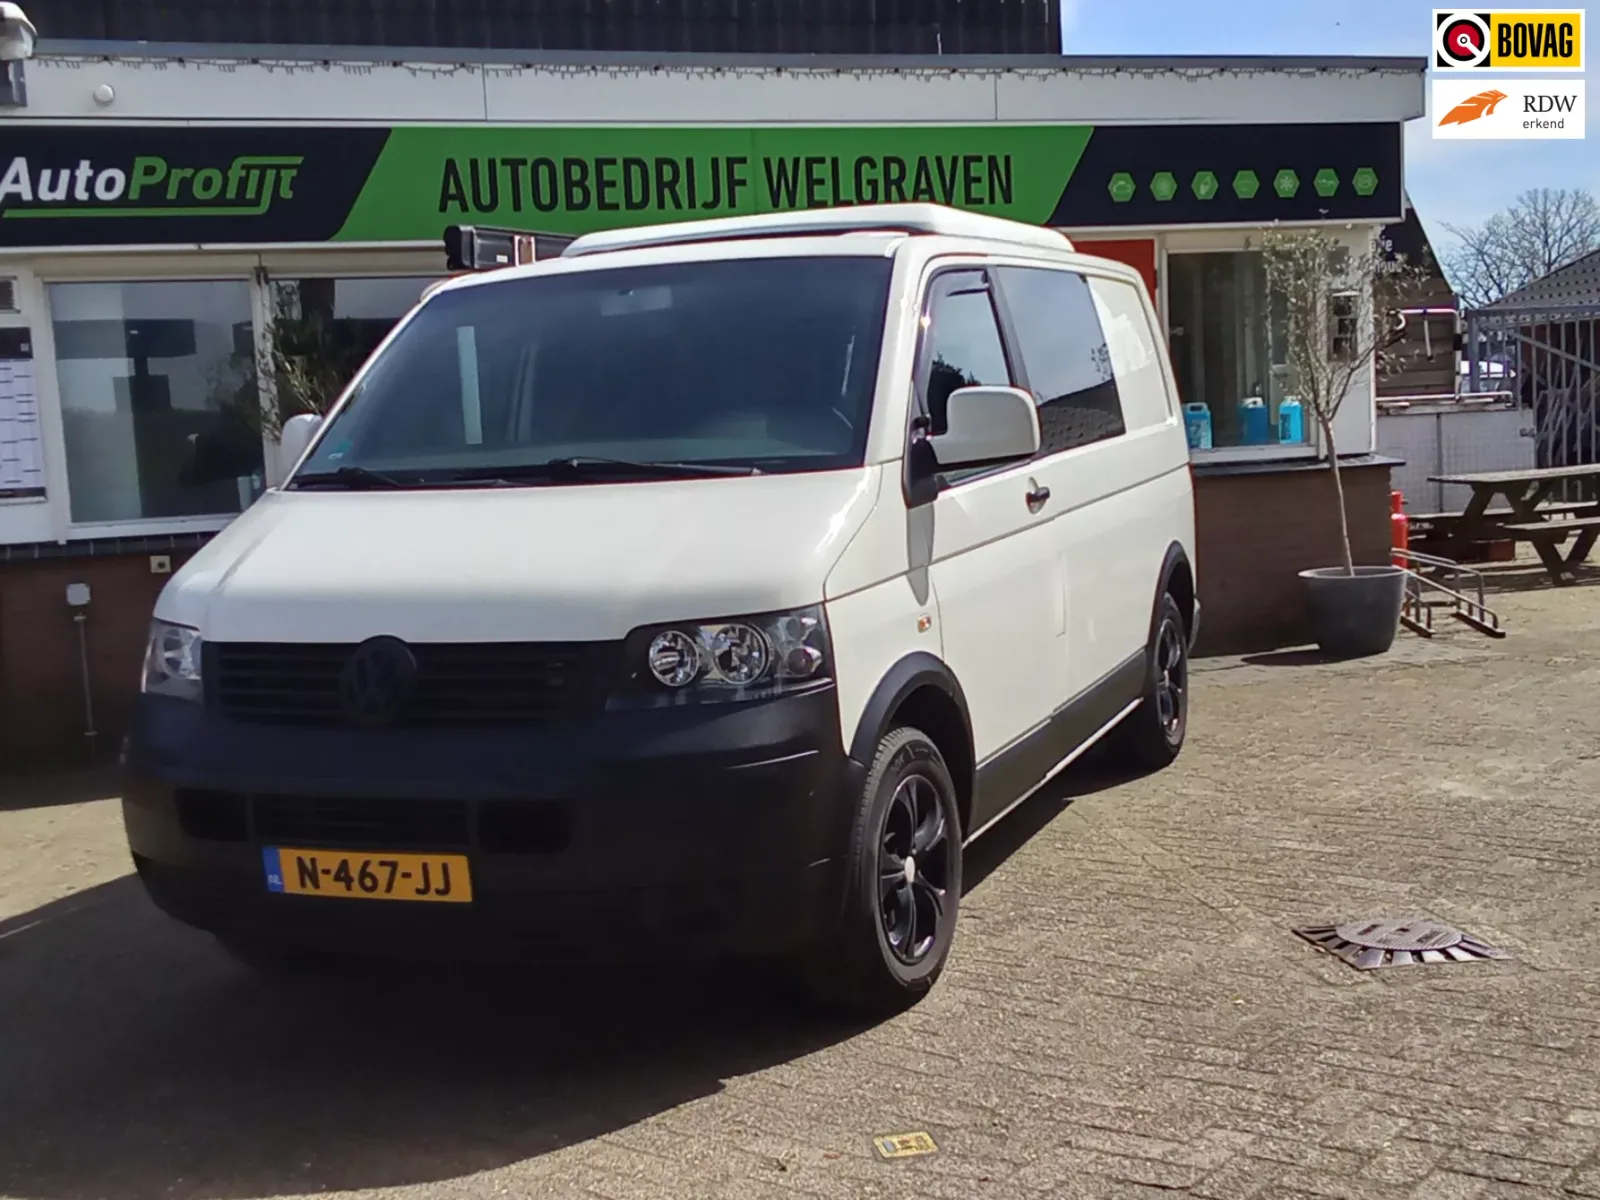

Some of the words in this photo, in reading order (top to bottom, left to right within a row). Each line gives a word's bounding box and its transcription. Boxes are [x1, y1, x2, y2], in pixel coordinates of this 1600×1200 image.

[0, 156, 304, 217] AutoProfijt
[438, 155, 748, 213] AUTOBEDRIJF
[764, 155, 1013, 209] WELGRAVEN
[296, 856, 452, 896] N-467-JJ
